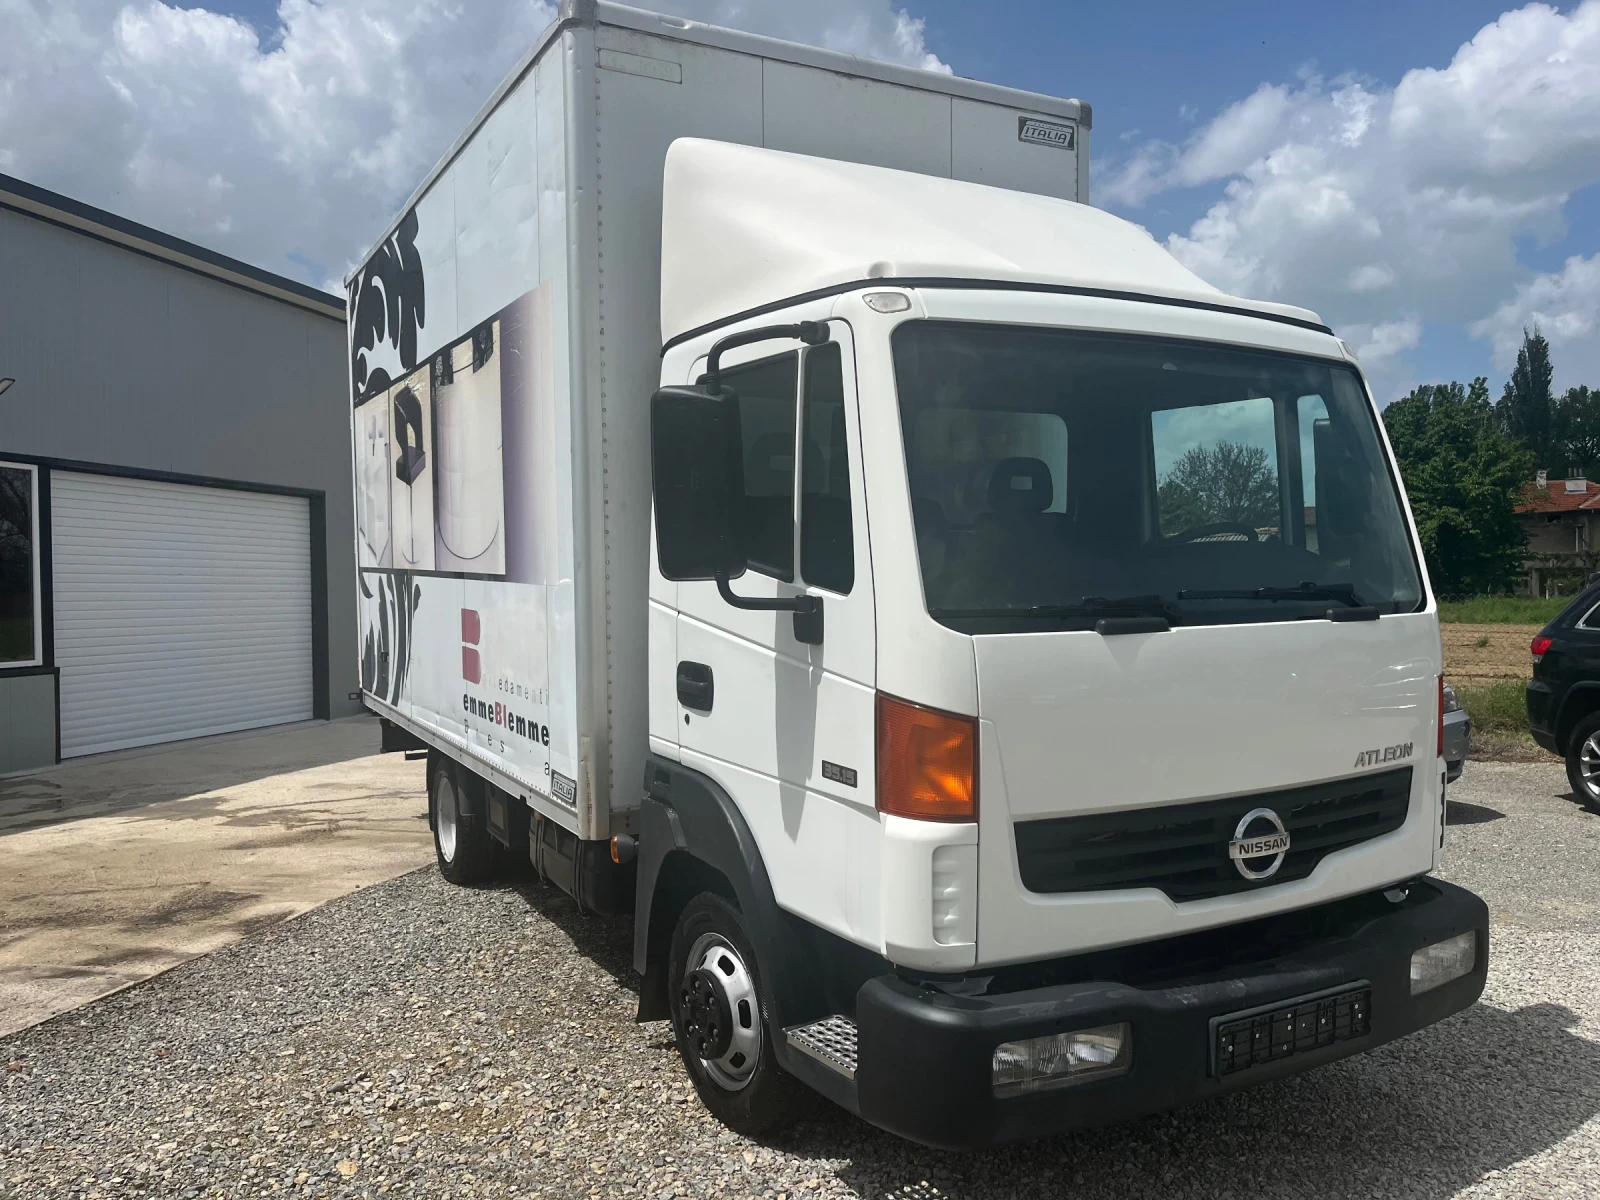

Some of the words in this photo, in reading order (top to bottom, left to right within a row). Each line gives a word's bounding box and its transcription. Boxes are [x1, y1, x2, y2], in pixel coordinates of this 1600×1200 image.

[1025, 127, 1067, 144] ITALIA
[1354, 742, 1413, 768] ATLEON
[553, 779, 573, 799] ITALIA
[1238, 837, 1288, 855] NISSAN
